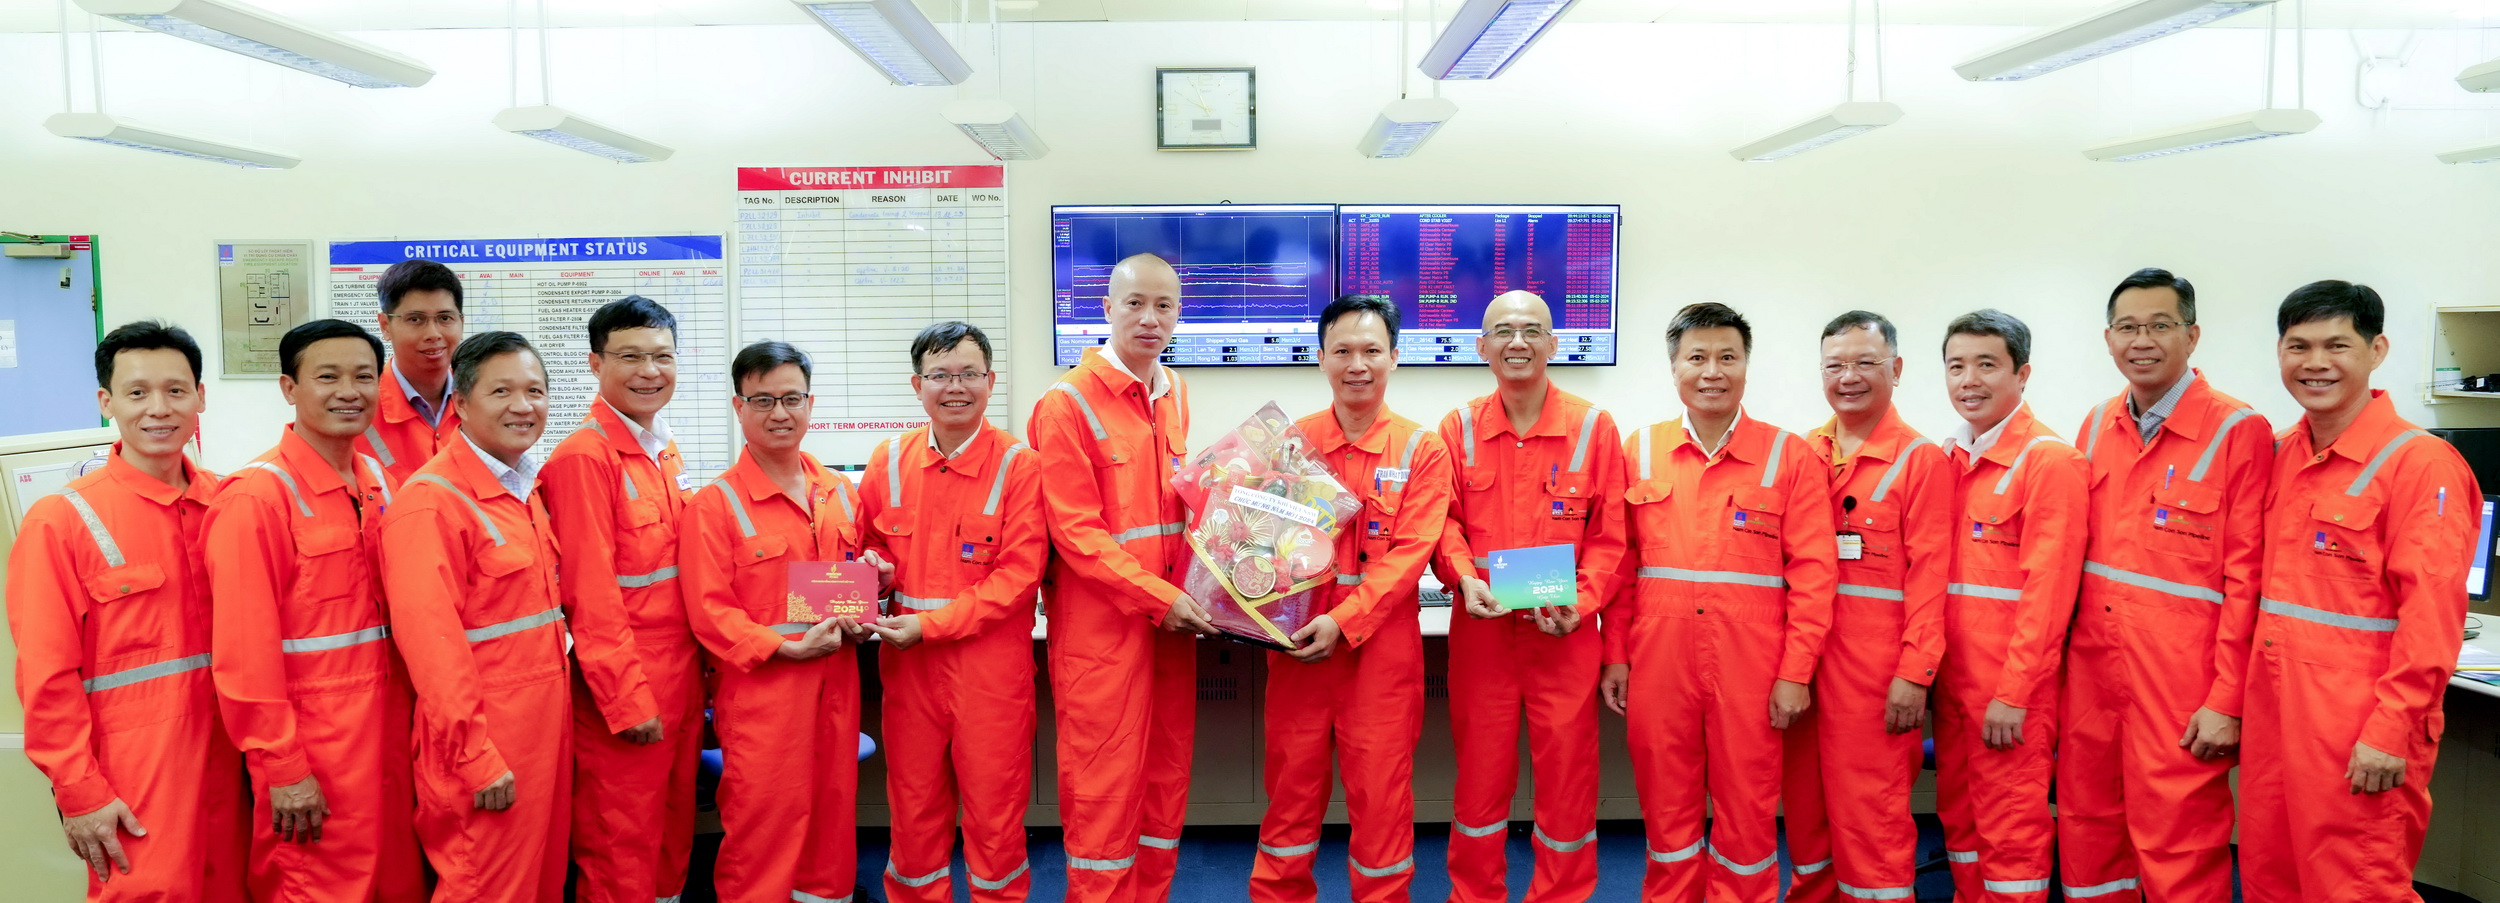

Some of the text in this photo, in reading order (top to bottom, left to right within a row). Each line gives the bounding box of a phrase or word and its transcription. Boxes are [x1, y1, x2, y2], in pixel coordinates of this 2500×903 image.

[790, 170, 952, 186] CURRENT INHIBIT
[785, 196, 840, 204] DESCRIPTION
[871, 195, 906, 203] REASON
[937, 194, 959, 202] DATE
[404, 241, 648, 259] CRITICAL EQUIPMENT STATUS
[808, 422, 831, 430] HORT
[857, 421, 904, 429] OPERATION
[19, 474, 32, 483] ABB
[1532, 585, 1564, 595] 2024
[833, 605, 865, 613] 2024
